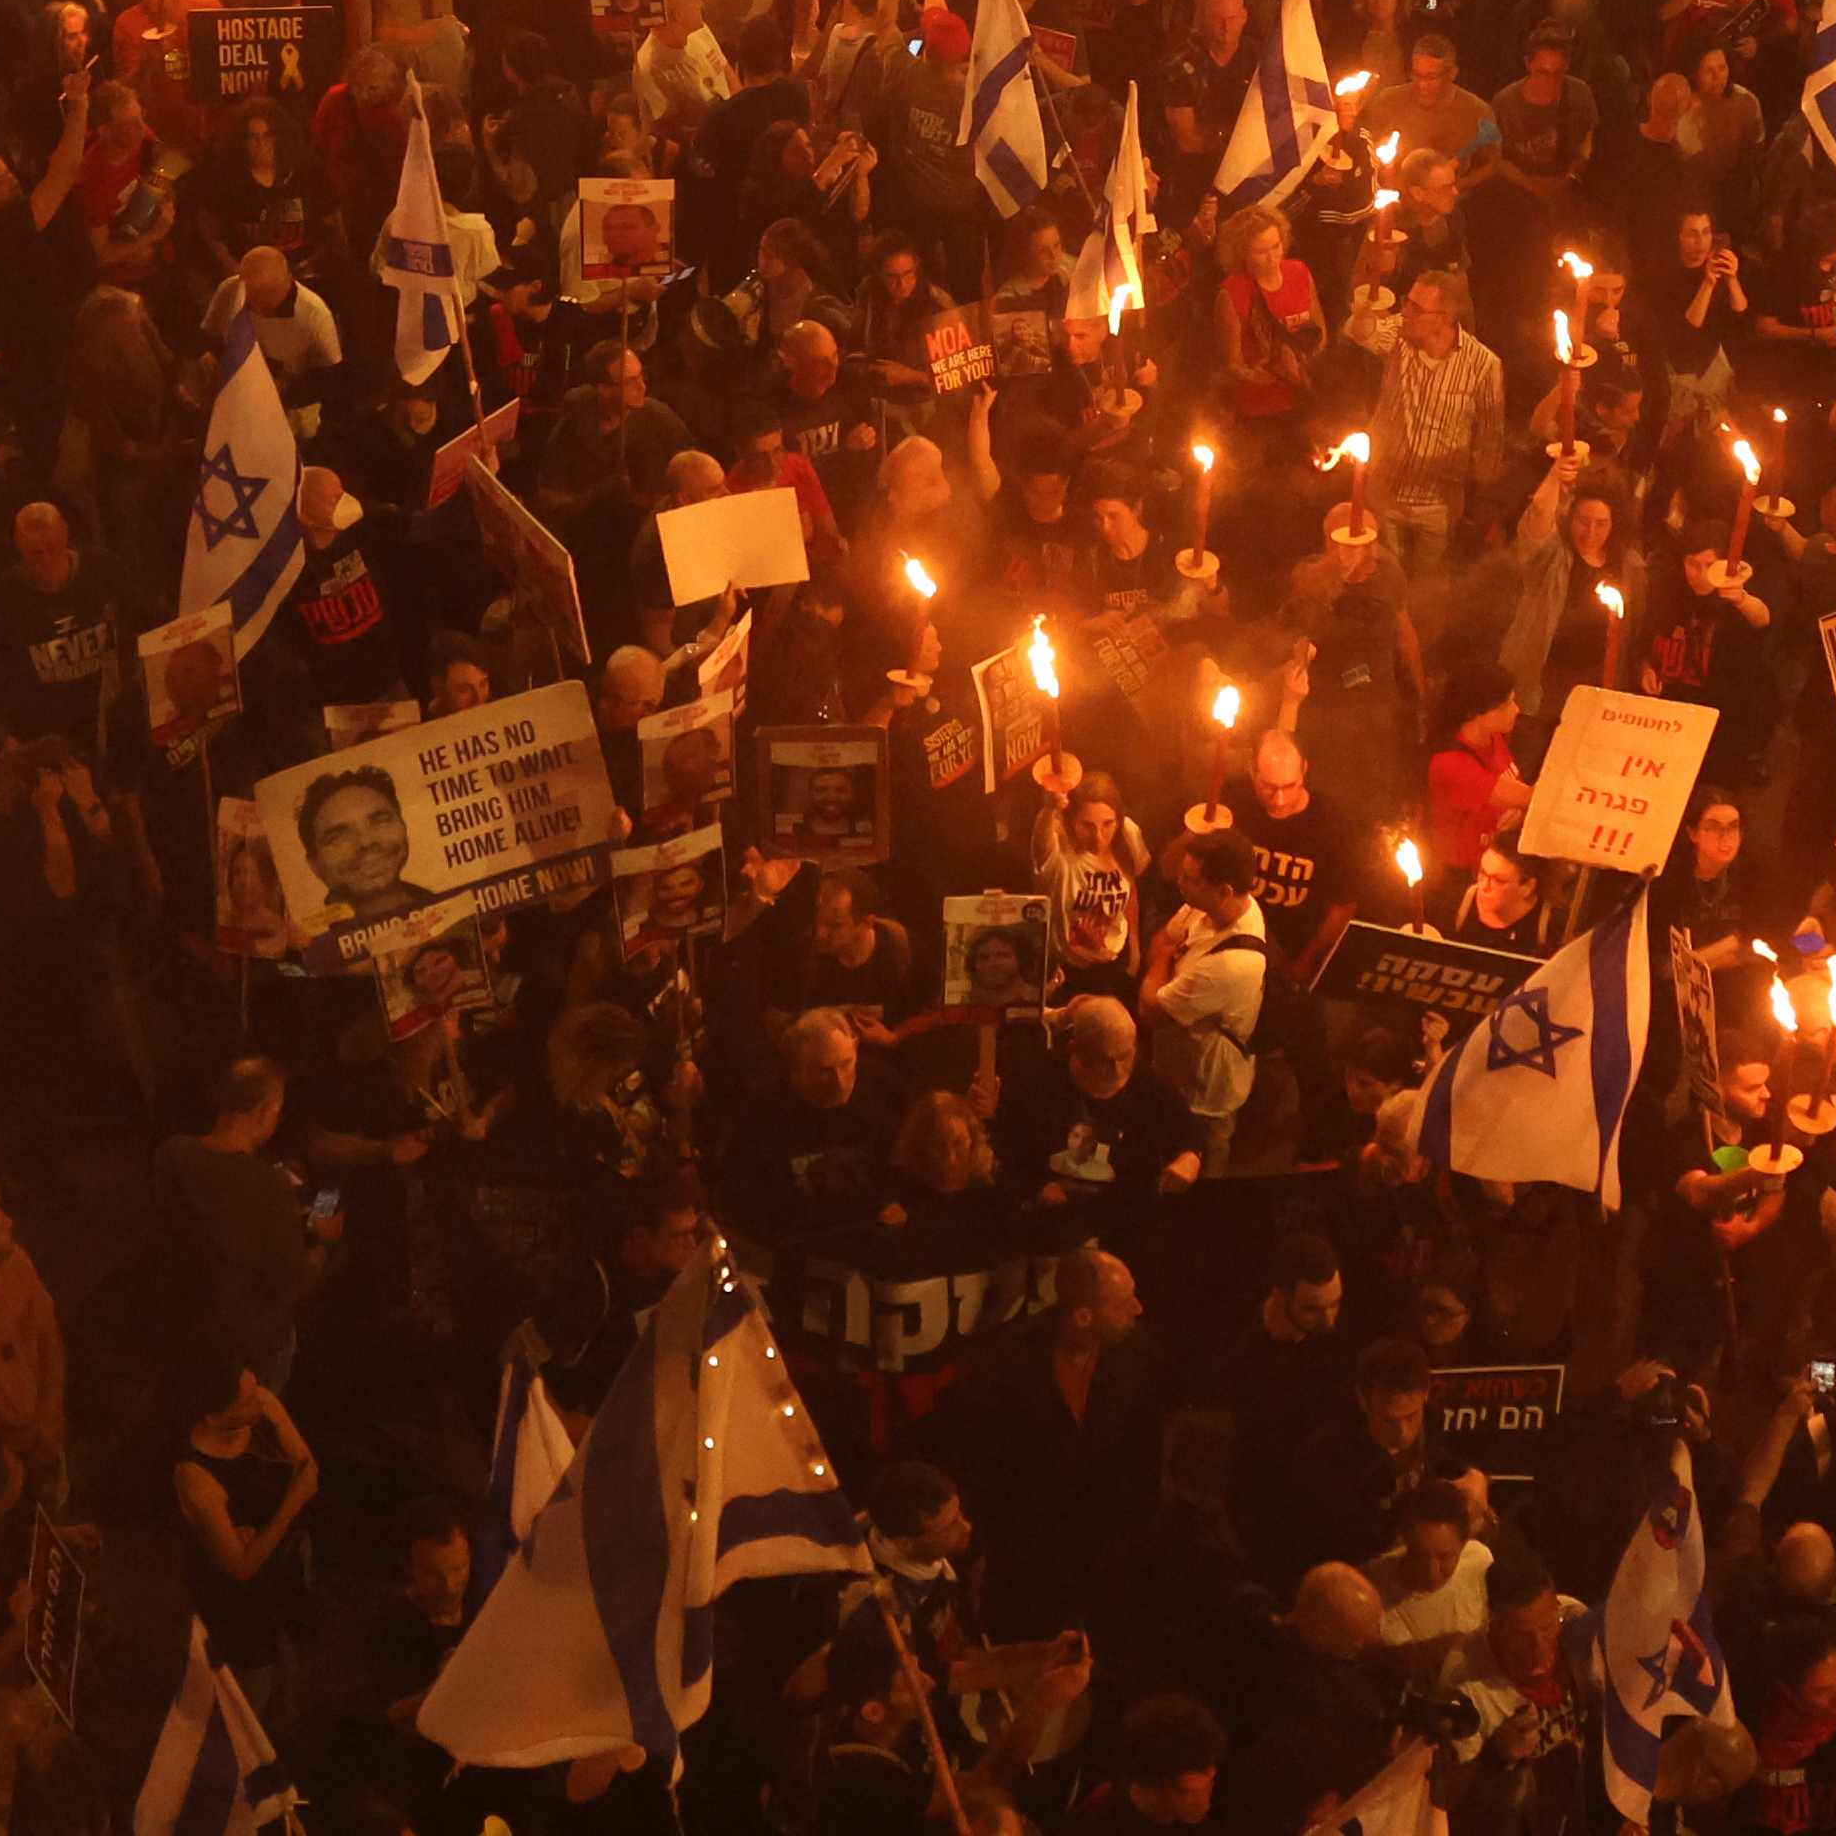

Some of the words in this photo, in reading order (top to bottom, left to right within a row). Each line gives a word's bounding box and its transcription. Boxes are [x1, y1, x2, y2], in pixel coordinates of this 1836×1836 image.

[217, 16, 304, 42] HOSTAGE
[218, 44, 269, 67] DEAL
[220, 70, 271, 96] NOW
[931, 359, 948, 375] WE
[947, 351, 967, 370] ARE
[966, 344, 994, 363] HERE
[935, 369, 963, 395] FOR
[1107, 589, 1149, 607] ISTERS
[1602, 708, 1684, 734] לחטופים
[419, 750, 447, 776] HE
[455, 731, 500, 764] HAS
[505, 720, 536, 749] NO
[1007, 727, 1042, 767] NOW
[428, 774, 484, 806] TIME
[486, 760, 516, 789] TO
[518, 740, 575, 775] WAIT
[1621, 755, 1667, 779] אין
[436, 794, 504, 836] BRING
[509, 781, 551, 816] HIM
[1575, 786, 1649, 817] פגרה
[445, 829, 509, 867] HOME
[514, 806, 581, 848] ALIVE!
[475, 870, 533, 915] HOME
[537, 854, 596, 899] NOW!
[1377, 953, 1506, 994] עסקה
[1442, 1405, 1488, 1432] יחז
[1500, 1405, 1544, 1431] הם
